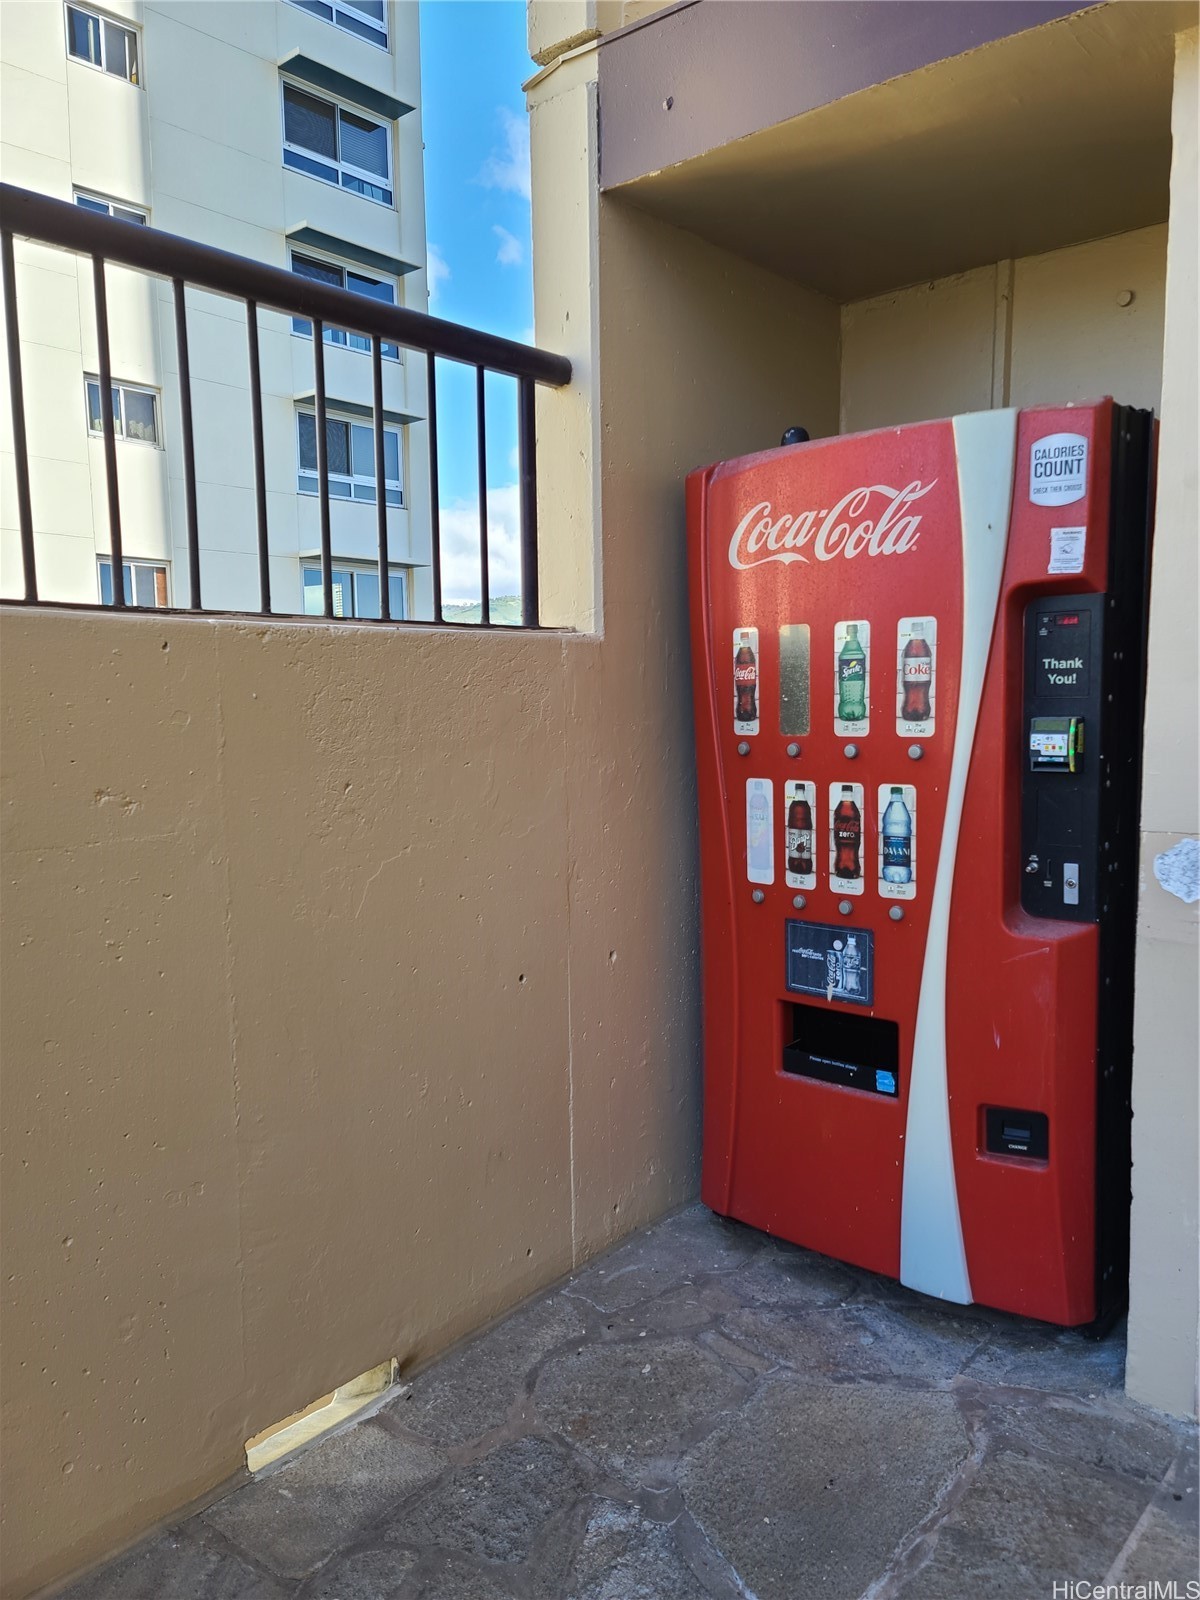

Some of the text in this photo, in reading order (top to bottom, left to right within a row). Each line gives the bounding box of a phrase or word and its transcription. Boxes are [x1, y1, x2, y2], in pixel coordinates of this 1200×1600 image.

[1034, 444, 1085, 461] CALORIES
[1034, 458, 1084, 478] COUNT
[728, 478, 938, 570] Coca-Cola
[904, 663, 931, 676] Coke
[1042, 657, 1083, 669] Thank
[842, 665, 863, 680] Sprite
[1047, 673, 1077, 685] You!
